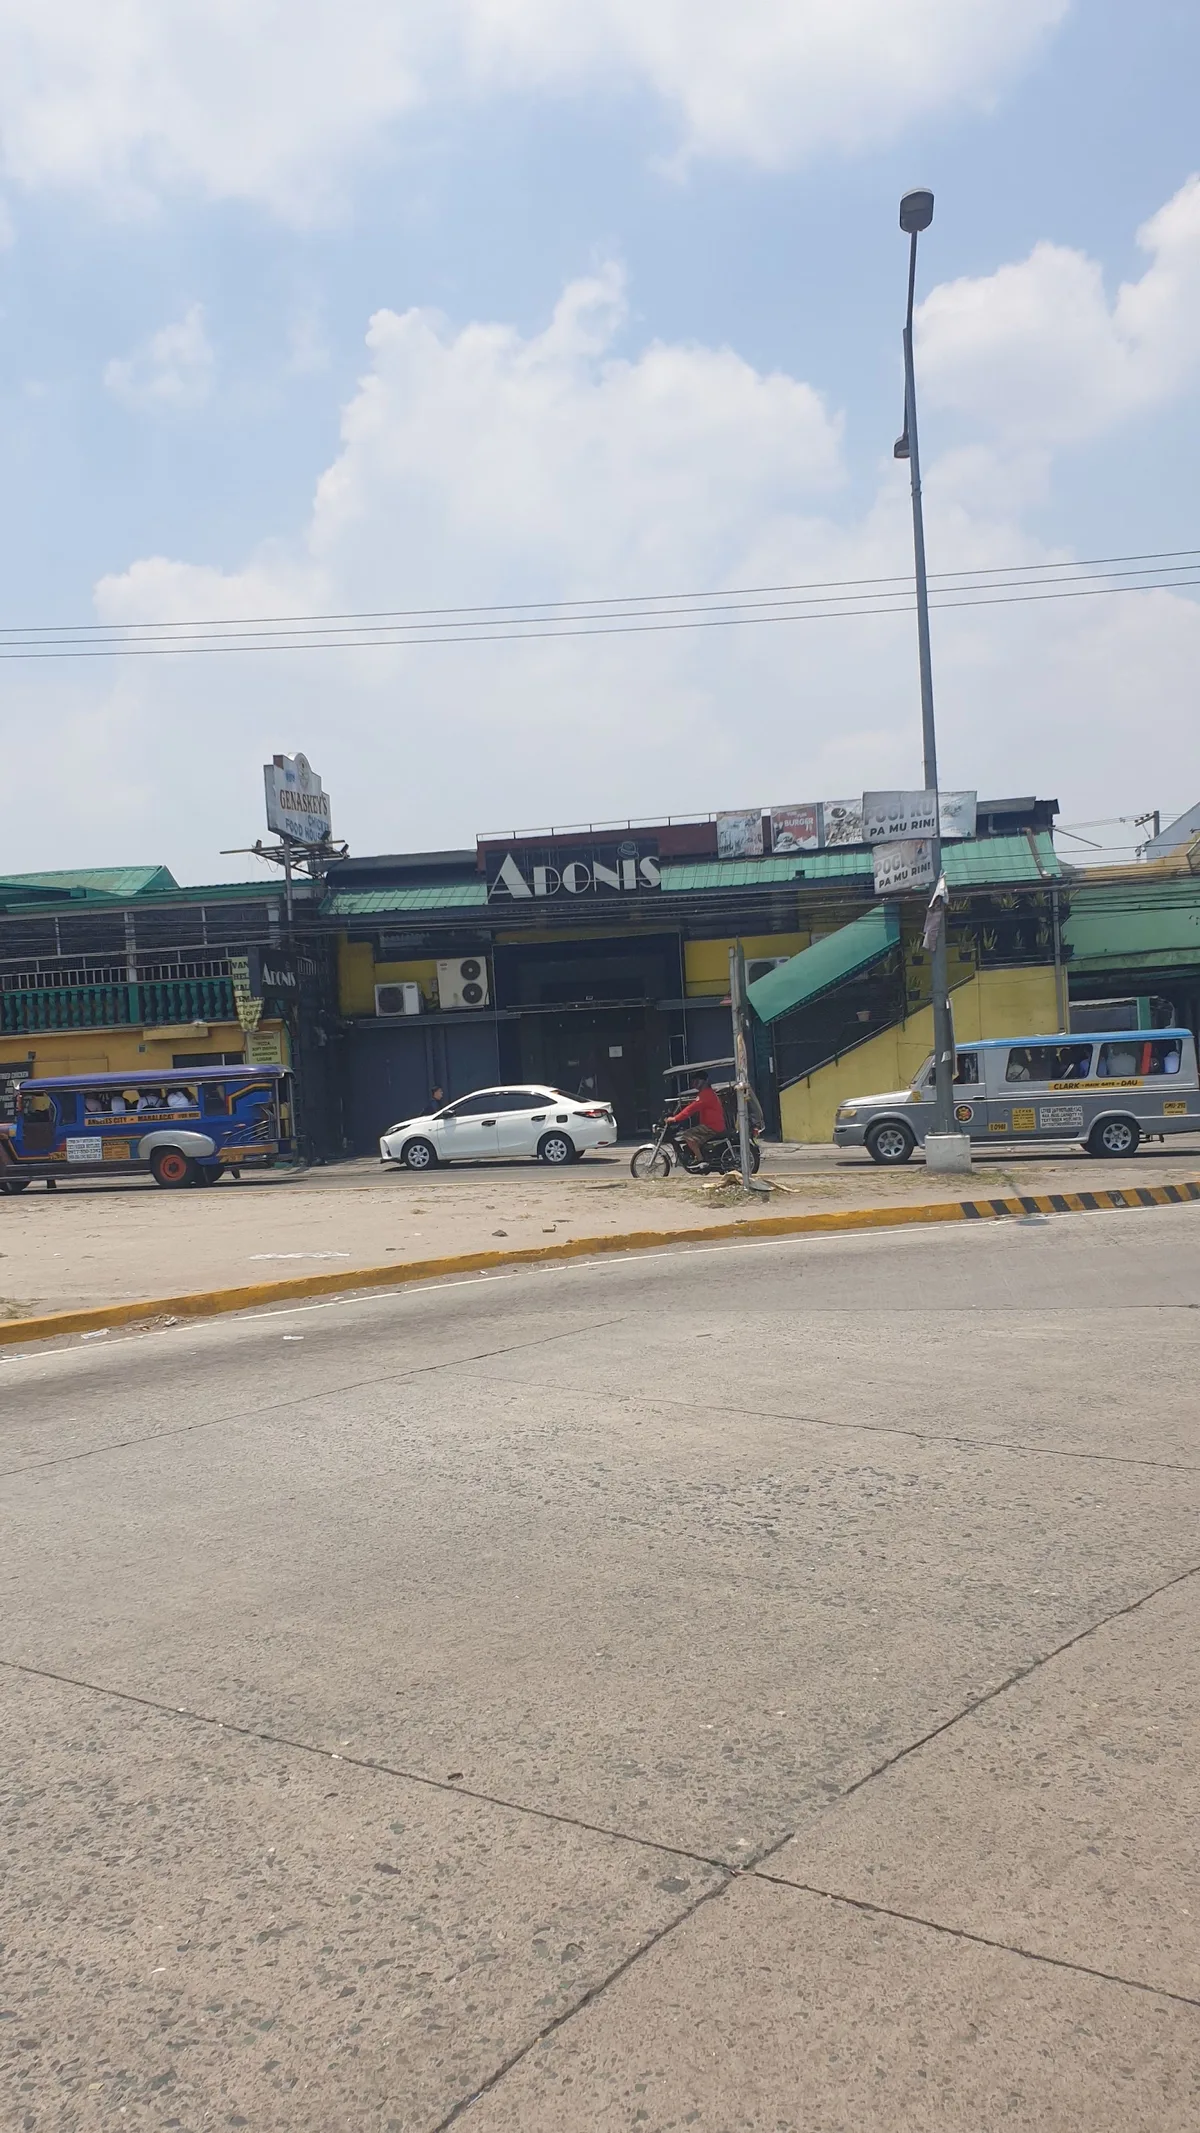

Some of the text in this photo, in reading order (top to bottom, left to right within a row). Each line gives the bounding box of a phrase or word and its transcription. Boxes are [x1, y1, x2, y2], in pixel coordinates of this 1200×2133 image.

[280, 789, 328, 815] GENASKEY'S
[285, 817, 303, 836] FOOD
[784, 817, 814, 828] BURGER
[870, 826, 885, 837] PA
[889, 822, 907, 834] MU
[911, 818, 935, 830] RIN!
[487, 852, 661, 900] ADONIS
[879, 862, 931, 889] PA MU RIN!
[262, 962, 296, 987] ADONIS
[1053, 1082, 1080, 1090] CLARK
[1120, 1079, 1138, 1087] DAU
[113, 1116, 127, 1124] CITY
